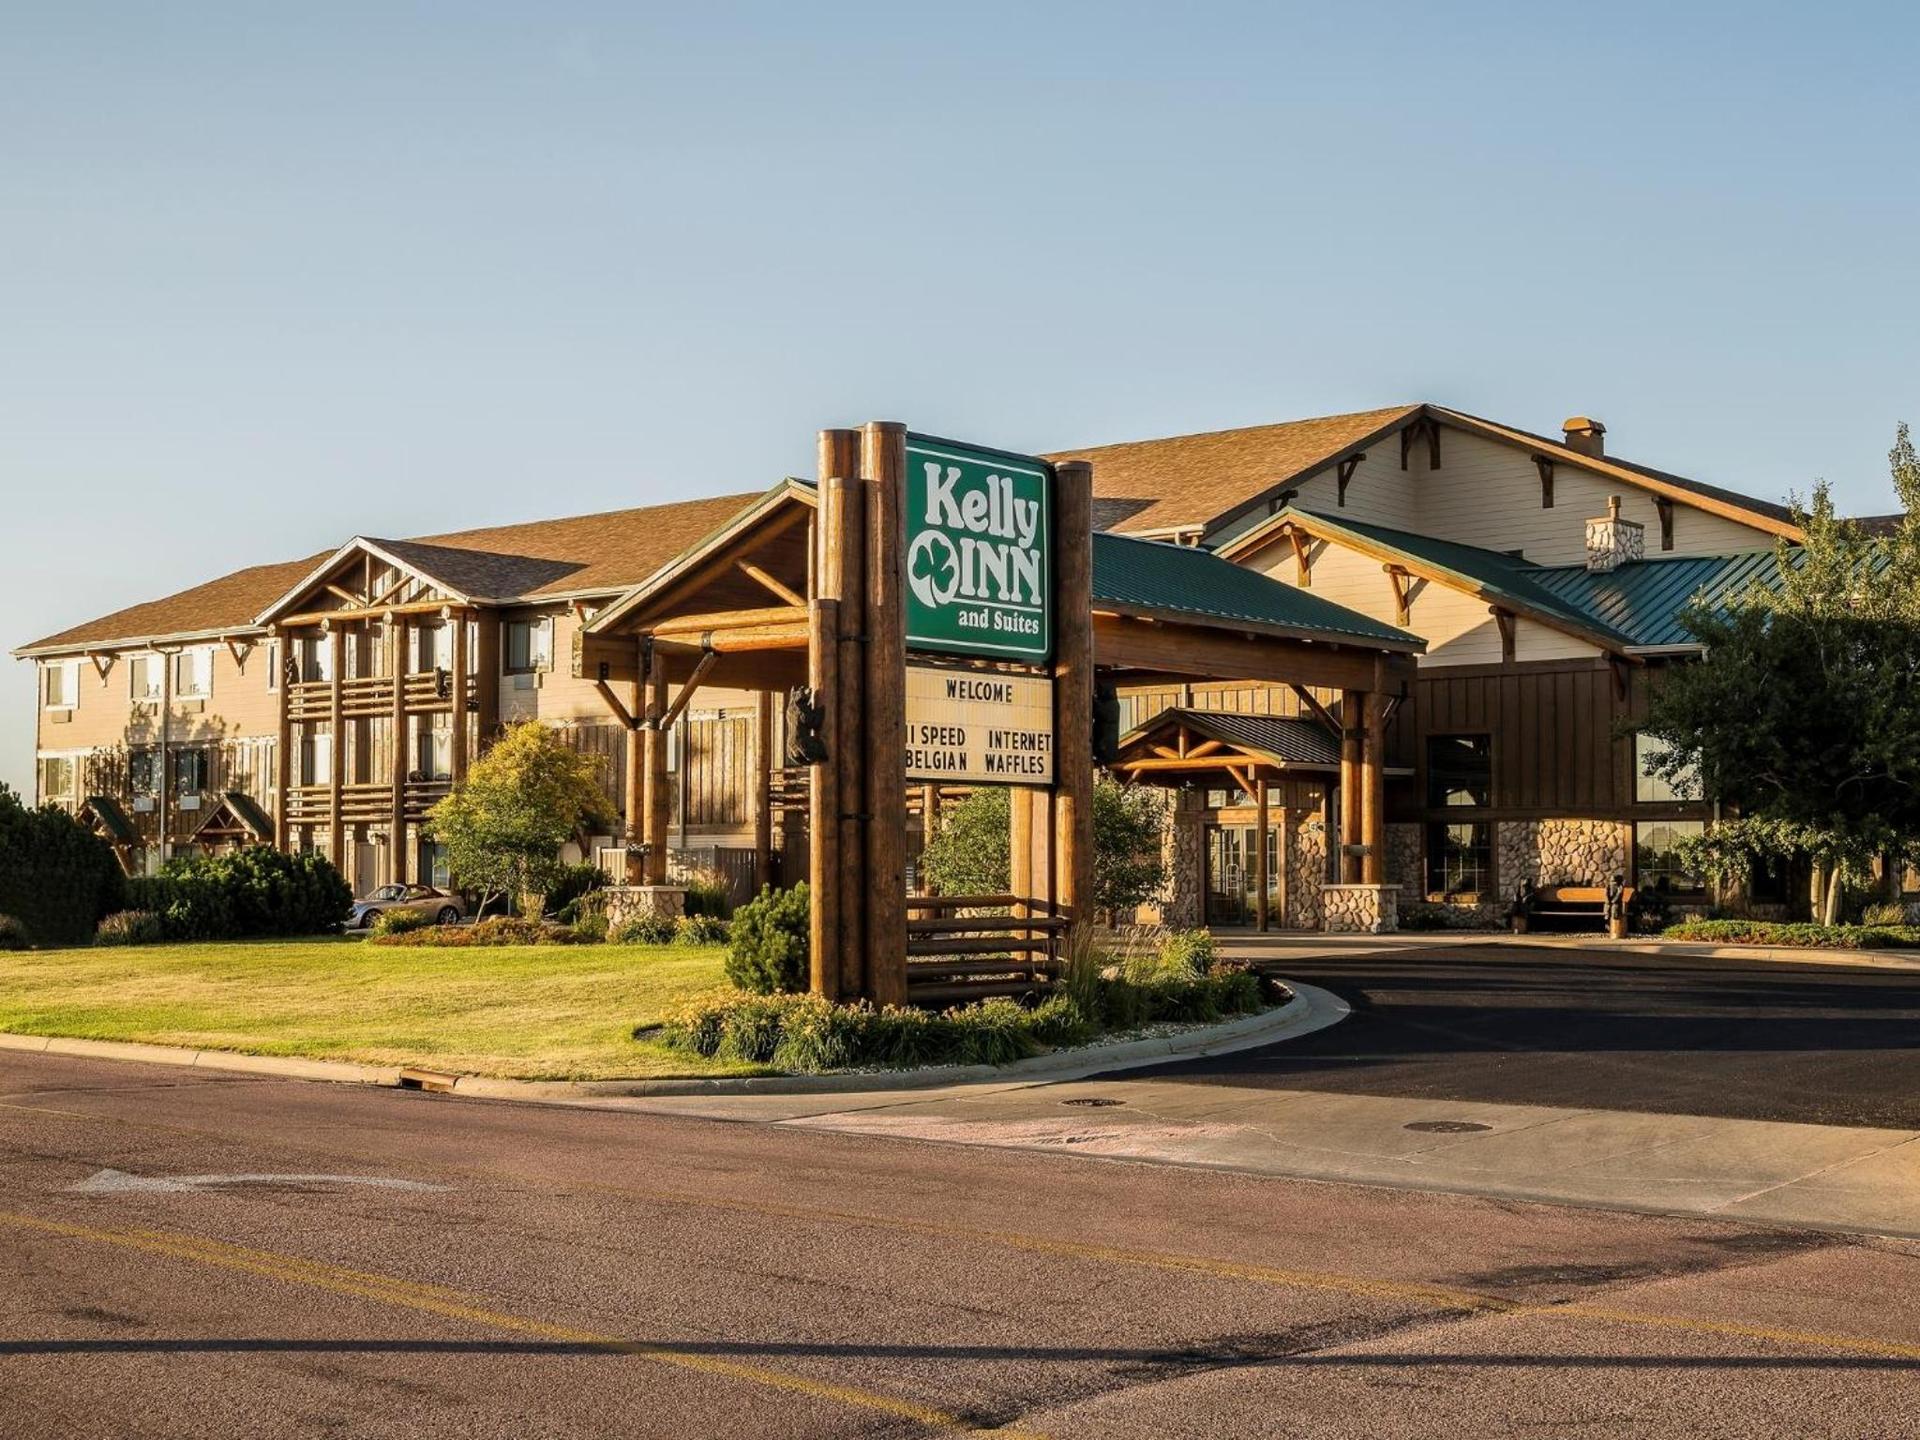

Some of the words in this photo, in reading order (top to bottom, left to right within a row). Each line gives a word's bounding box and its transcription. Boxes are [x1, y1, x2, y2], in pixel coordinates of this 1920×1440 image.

[924, 462, 1038, 548] Kelly
[959, 537, 1041, 605] INN
[958, 608, 988, 629] and
[994, 611, 1038, 635] Suites
[946, 679, 1012, 703] WELCOME
[921, 725, 966, 746] SPEED
[989, 730, 1051, 752] INTERNET
[906, 750, 967, 771] BELGIAN
[985, 754, 1044, 774] WAFFLES
